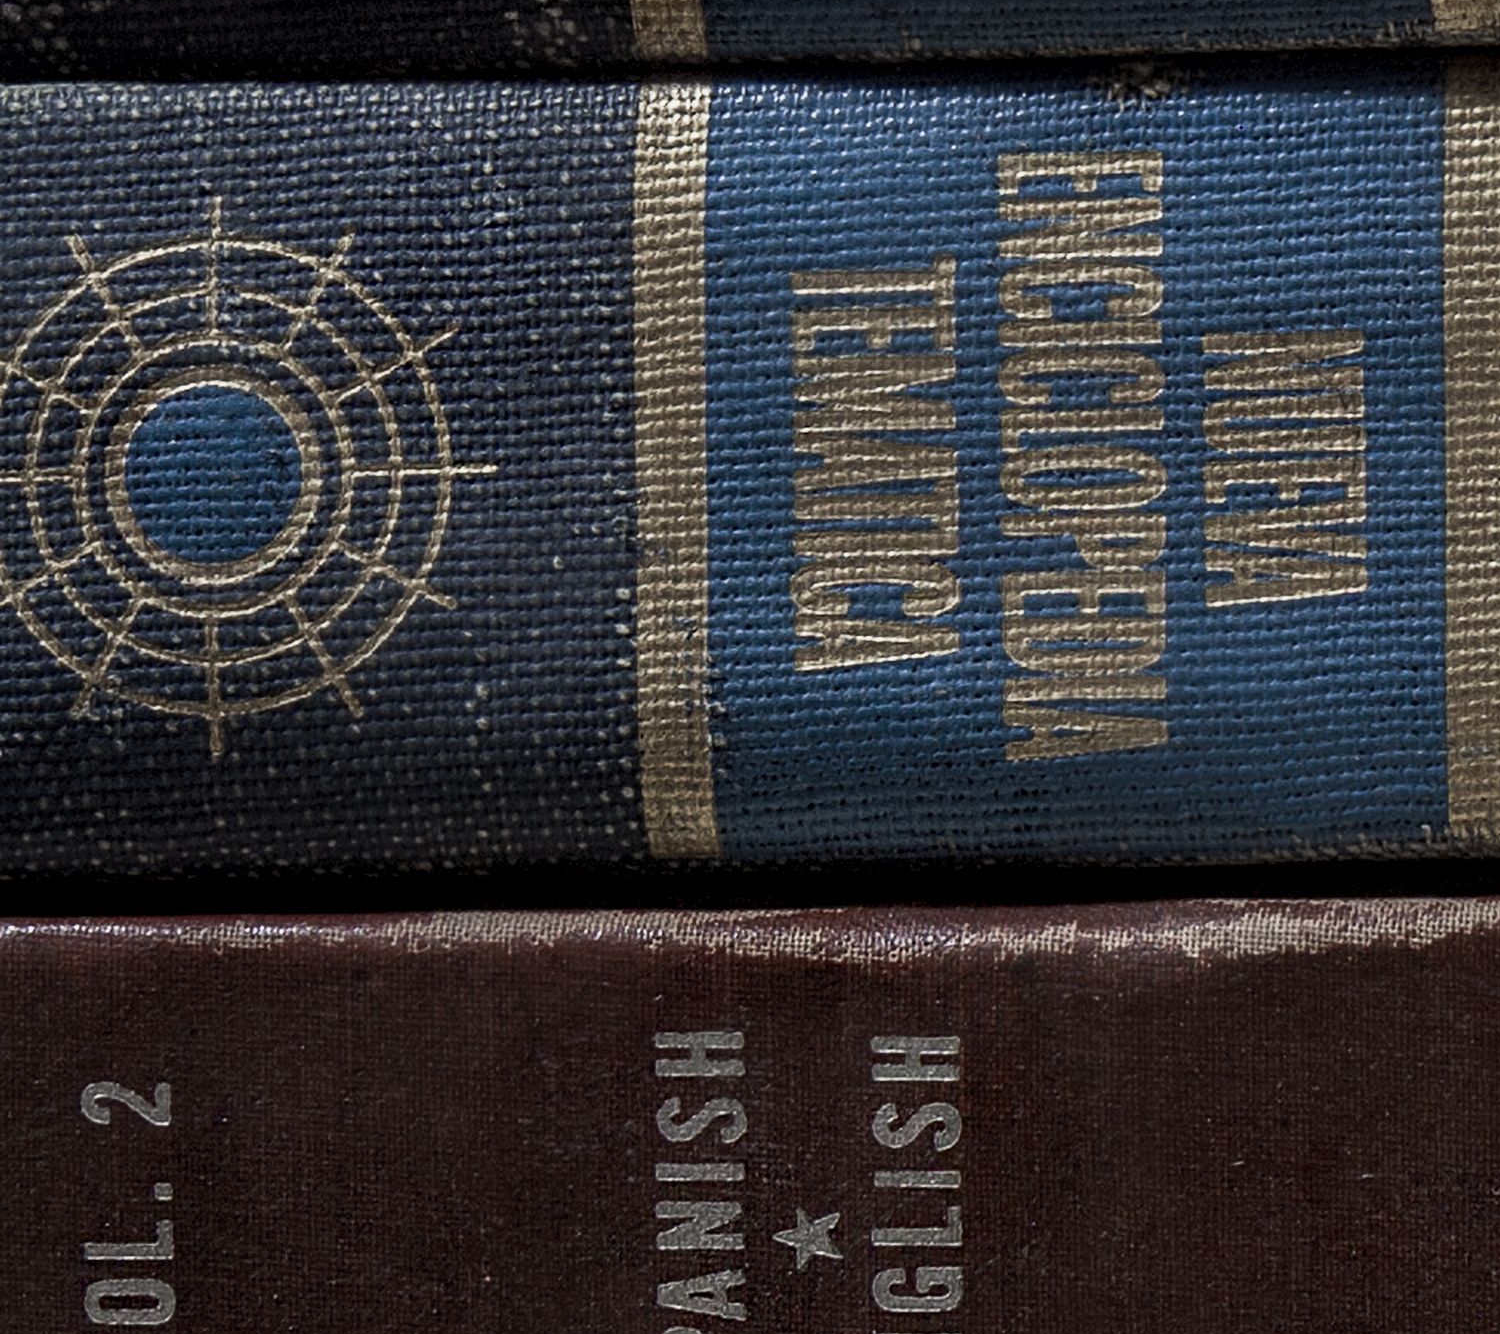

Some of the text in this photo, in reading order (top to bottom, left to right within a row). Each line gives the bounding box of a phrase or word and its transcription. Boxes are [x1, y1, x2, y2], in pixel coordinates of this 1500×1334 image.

[791, 257, 958, 669] TEMATICA
[998, 152, 1165, 762] ENCICLOPEDIA
[1203, 330, 1366, 605] NUEVA
[82, 1080, 170, 1126] 2
